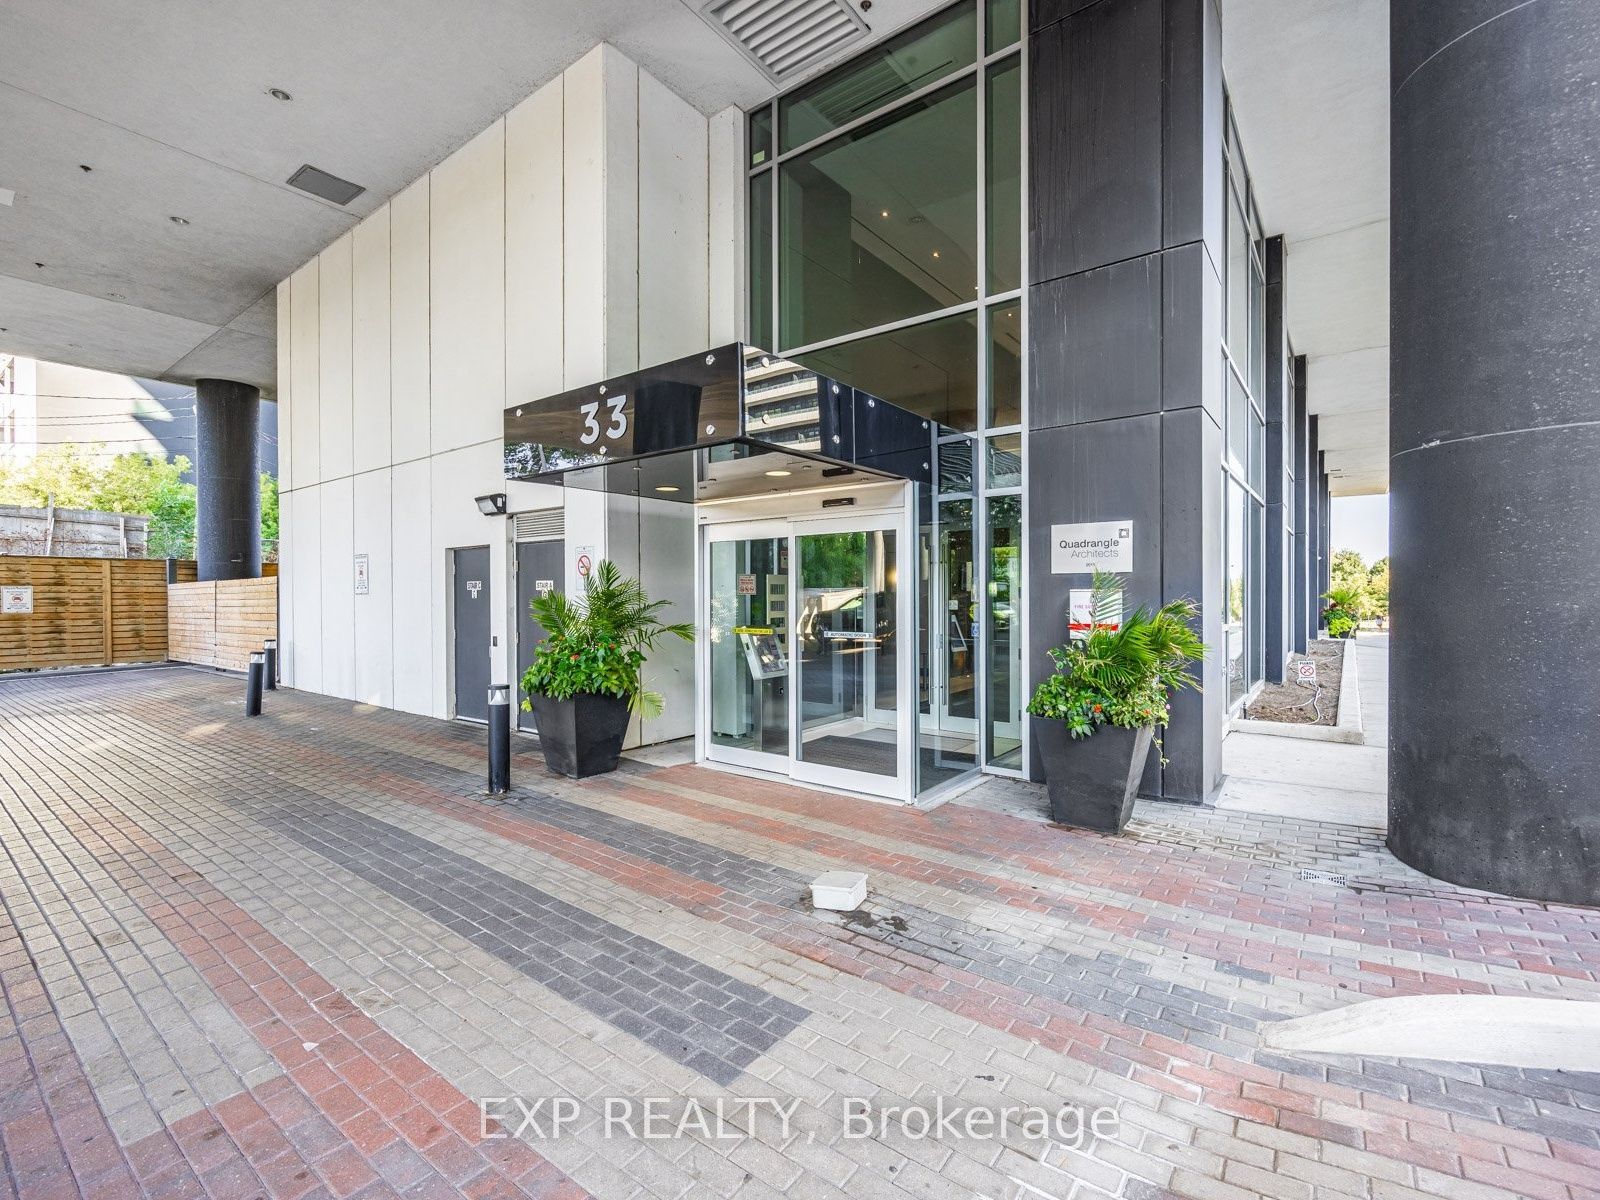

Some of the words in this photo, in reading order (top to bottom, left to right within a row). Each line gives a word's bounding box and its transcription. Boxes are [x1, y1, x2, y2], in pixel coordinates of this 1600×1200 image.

[580, 394, 628, 445] 33
[1059, 538, 1119, 549] Quadrangle
[1070, 549, 1119, 558] Architects
[536, 582, 548, 590] STAIR
